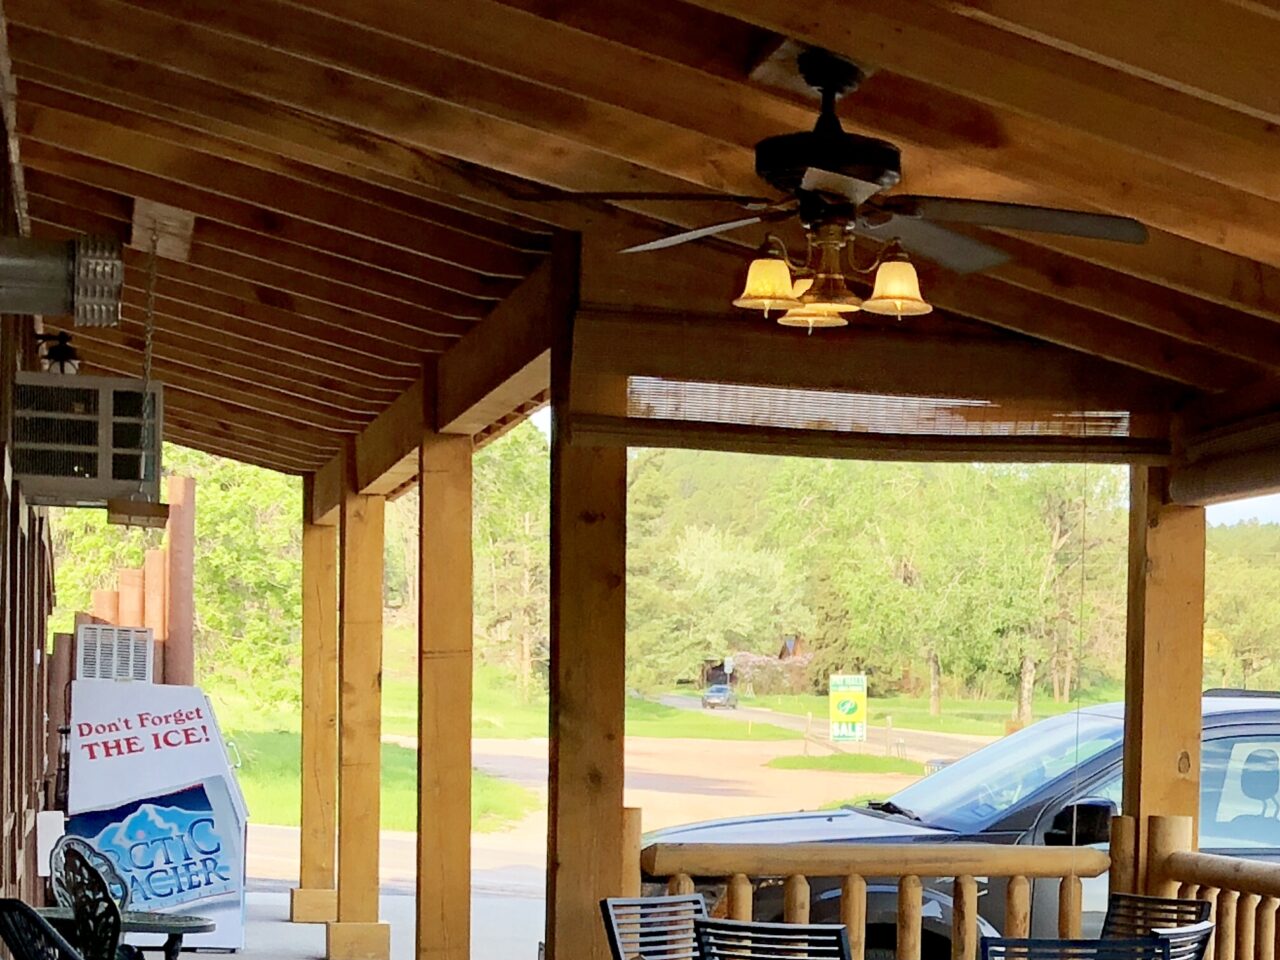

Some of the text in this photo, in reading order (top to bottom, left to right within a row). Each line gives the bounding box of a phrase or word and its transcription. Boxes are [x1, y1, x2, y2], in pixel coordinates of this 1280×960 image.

[77, 707, 203, 737] Don't Forget
[81, 725, 210, 760] THE ICE!
[103, 818, 221, 873] RCTIC
[130, 857, 230, 904] ACIER
